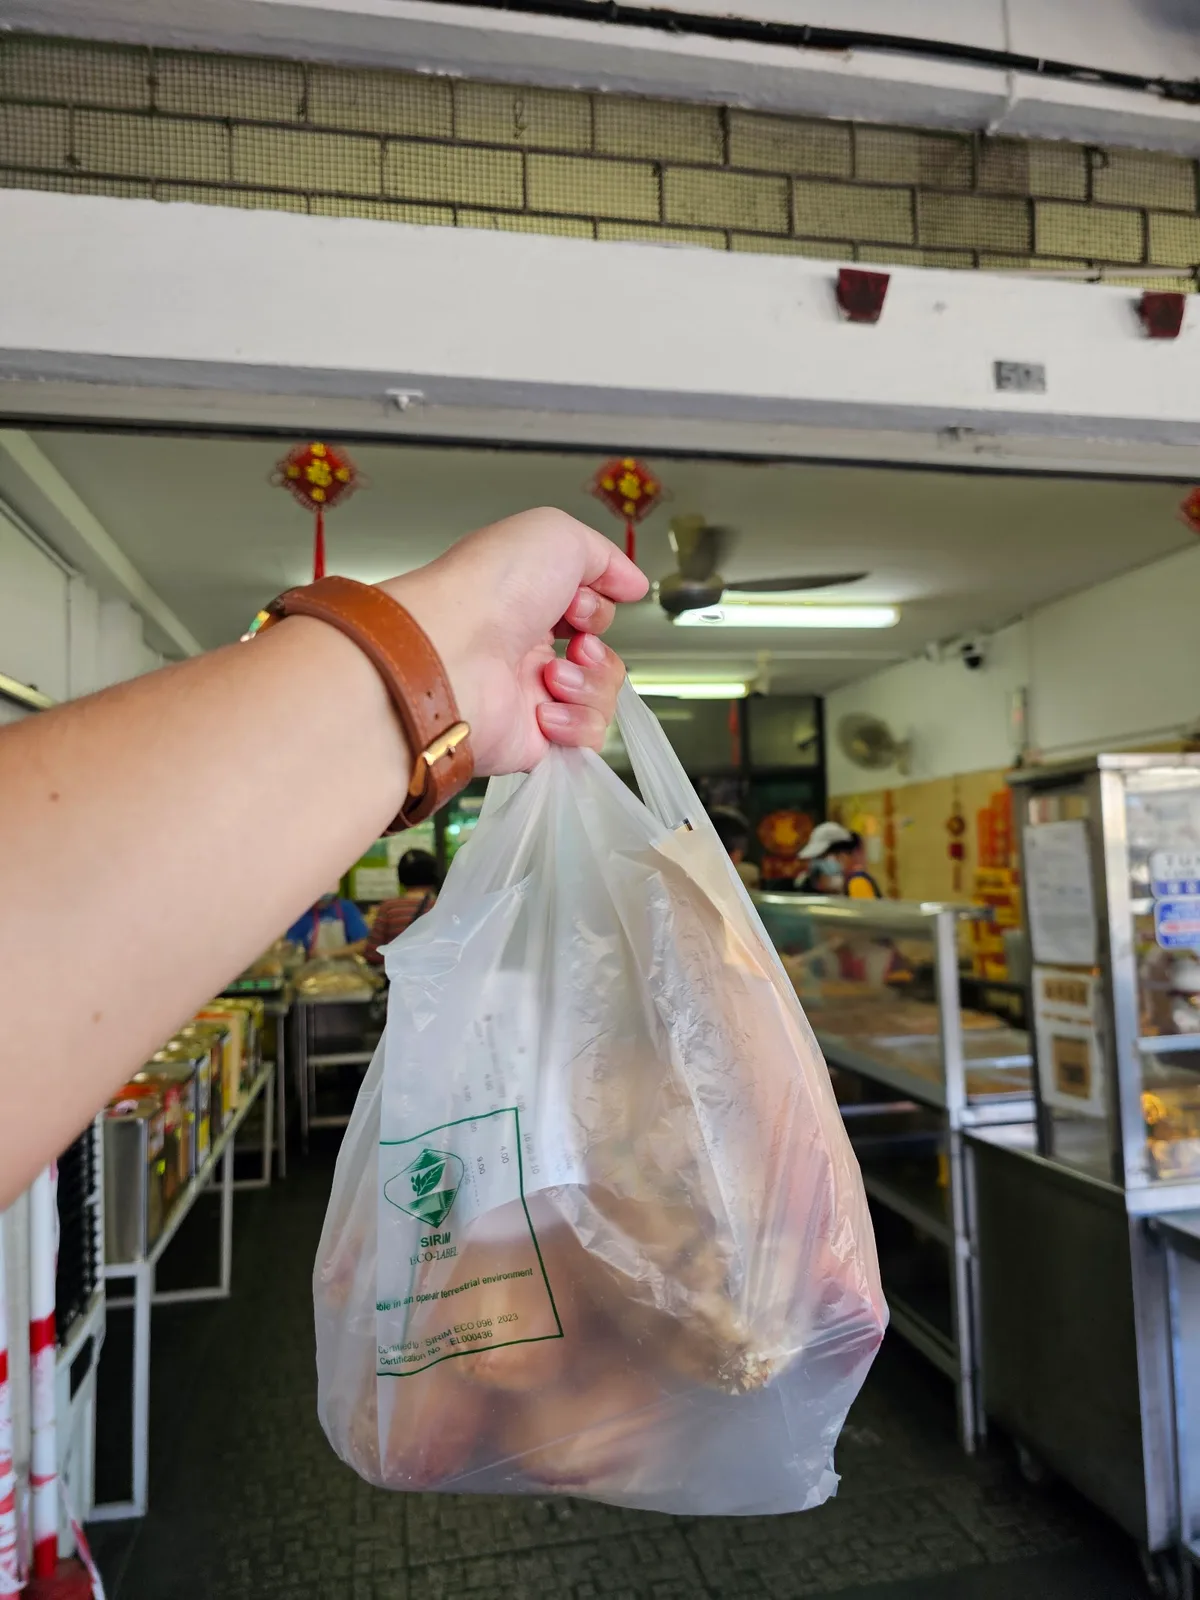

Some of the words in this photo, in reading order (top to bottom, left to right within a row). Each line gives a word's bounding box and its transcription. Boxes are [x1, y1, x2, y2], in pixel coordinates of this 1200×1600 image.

[499, 1145, 510, 1164] 4.00
[476, 1155, 486, 1175] 9.00
[420, 1231, 451, 1248] SIRIM
[409, 1246, 458, 1266] ECO-LABEL
[393, 1299, 401, 1309] in
[403, 1296, 414, 1305] an
[440, 1277, 480, 1299] terrestrial
[482, 1267, 533, 1285] environment
[425, 1329, 452, 1347] SIRIM
[453, 1321, 475, 1334] ECO
[497, 1312, 519, 1324] 2023
[379, 1351, 426, 1366] Certification
[427, 1346, 441, 1356] No
[449, 1330, 493, 1346] EL000436
